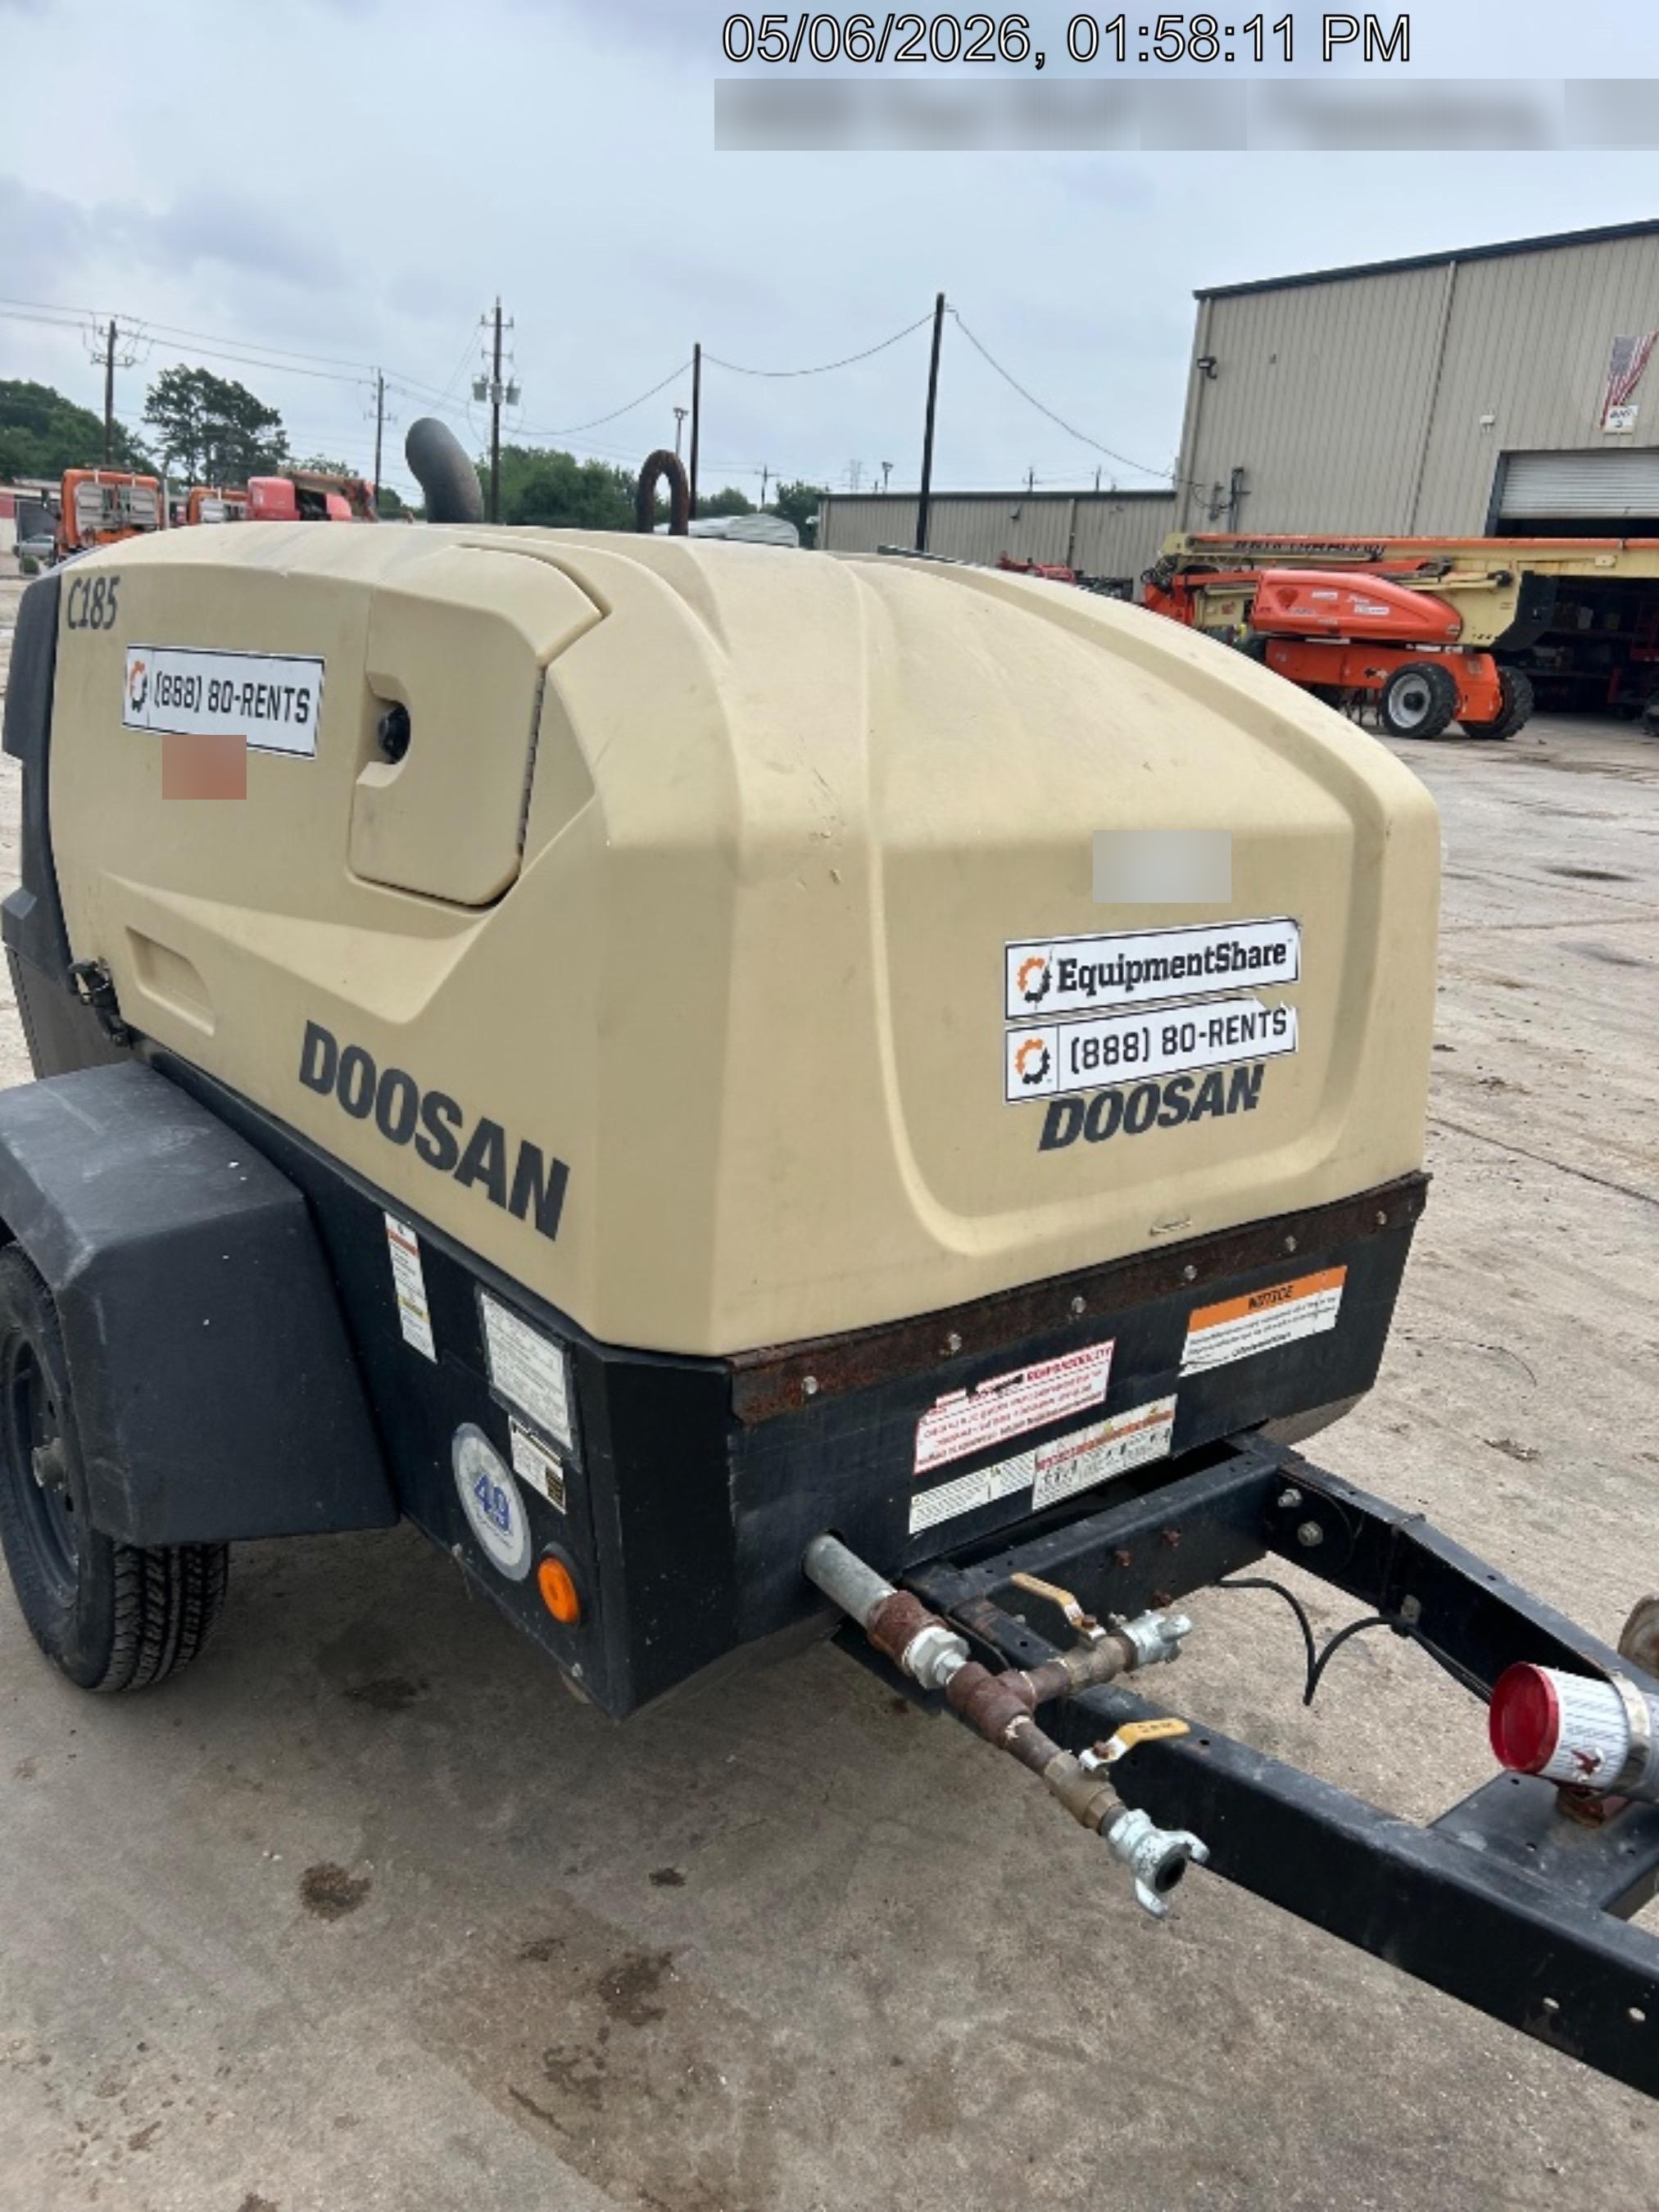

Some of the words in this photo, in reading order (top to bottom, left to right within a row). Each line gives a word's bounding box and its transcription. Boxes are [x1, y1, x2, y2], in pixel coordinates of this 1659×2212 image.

[66, 575, 121, 630] C185
[154, 671, 202, 712] (888)
[208, 682, 310, 724] 80-RENTS
[1058, 941, 1286, 996] EquipmentShare
[1072, 1027, 1149, 1074] (888)
[1162, 1008, 1287, 1055] 80-RENTS
[299, 1019, 570, 1241] DOOSAN
[1038, 1064, 1266, 1152] DOOSAN
[474, 1475, 510, 1531] 49
